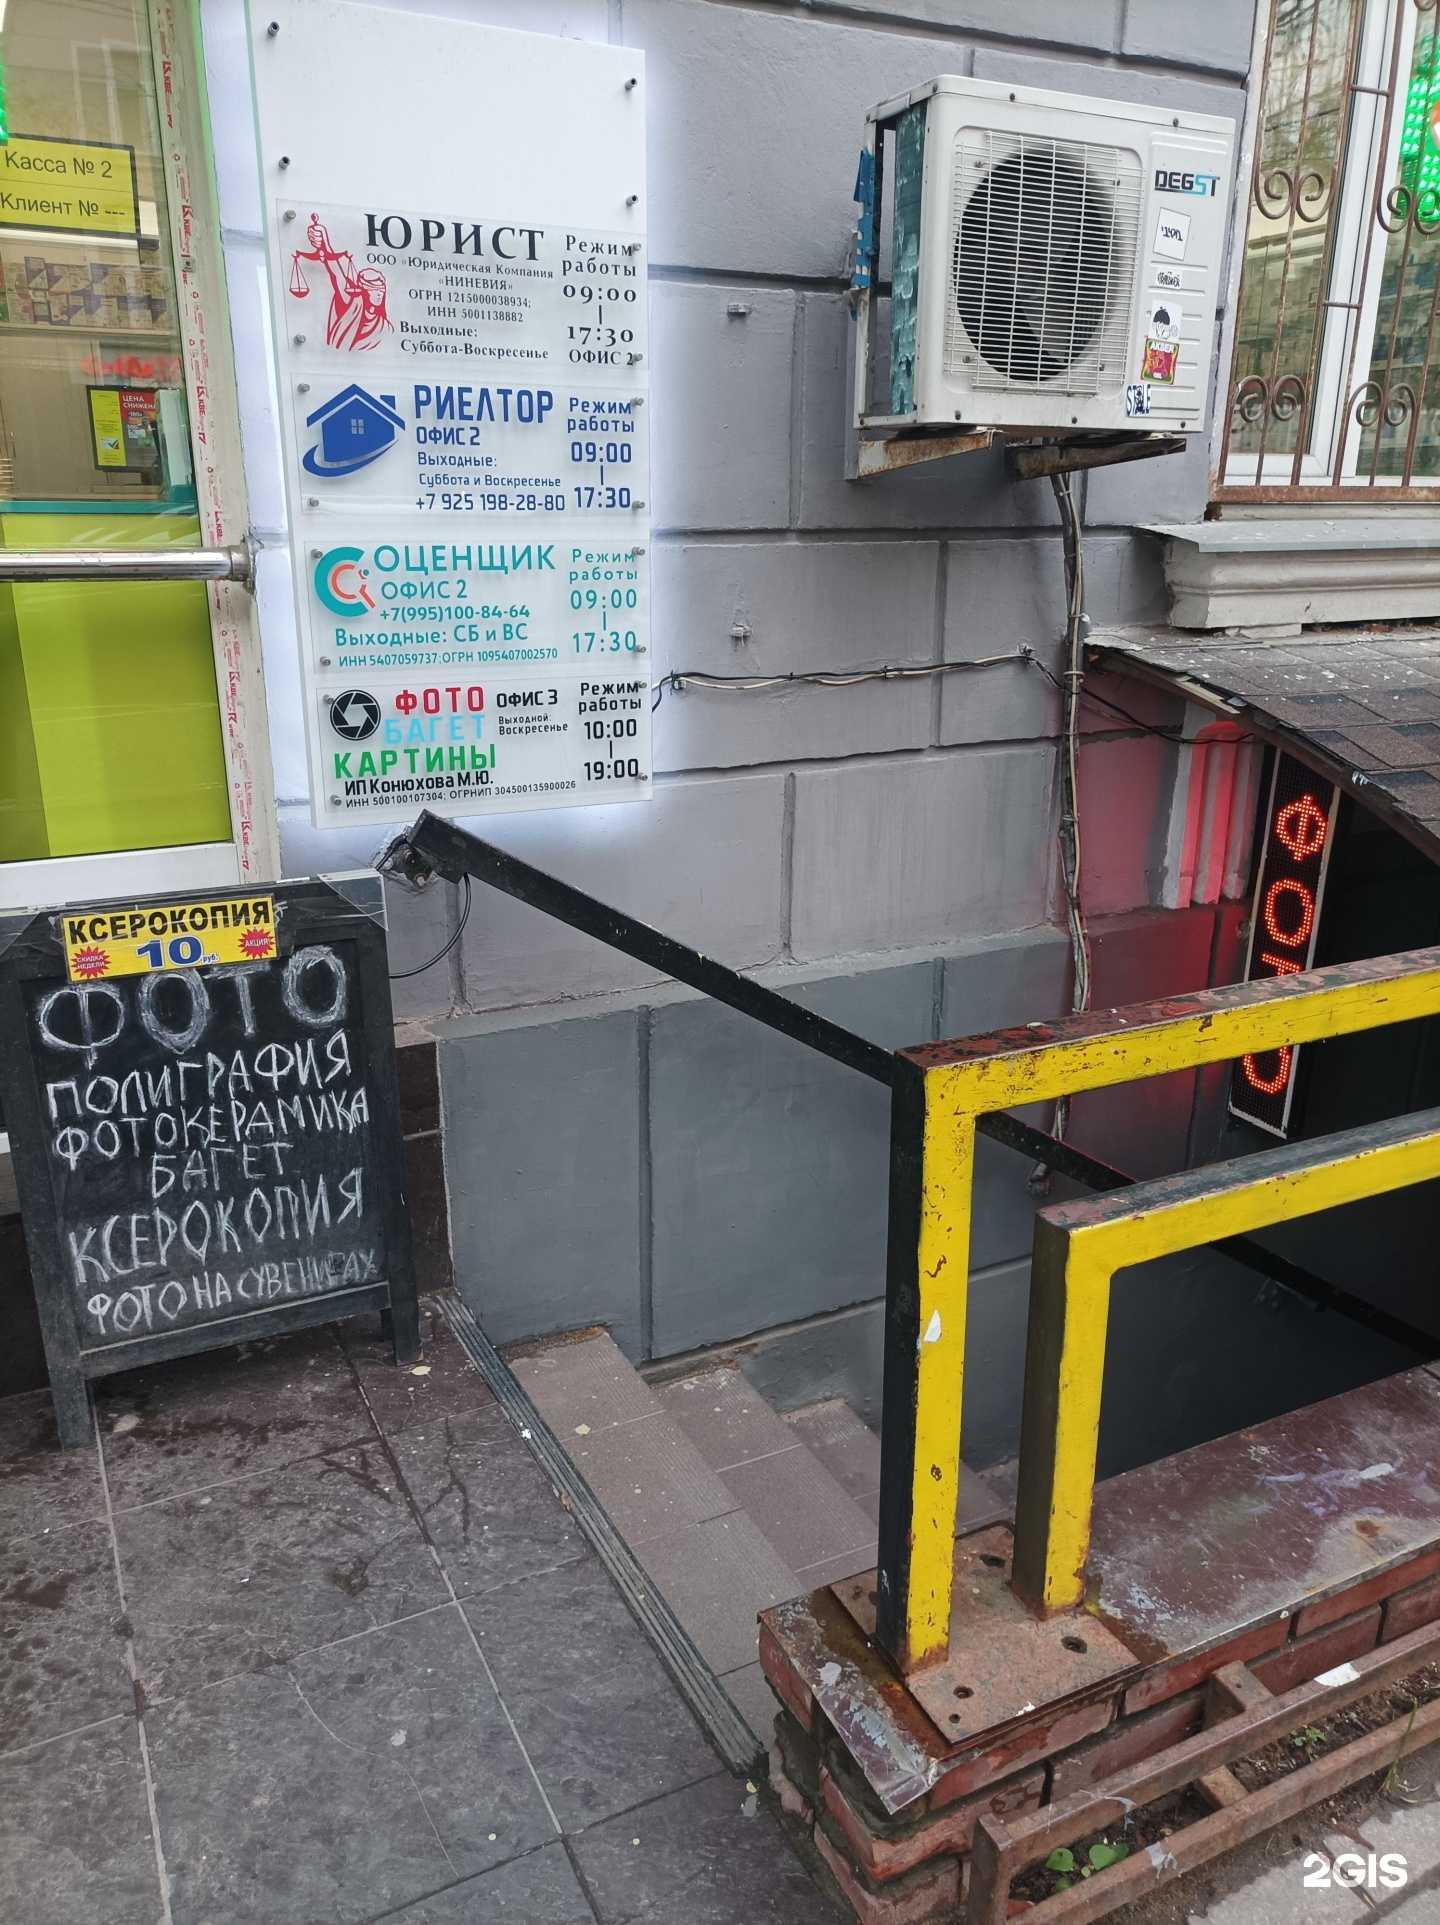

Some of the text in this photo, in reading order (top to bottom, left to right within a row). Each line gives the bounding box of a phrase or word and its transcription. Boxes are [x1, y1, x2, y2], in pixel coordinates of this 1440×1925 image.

[4, 150, 113, 179] Касса № 2
[1154, 170, 1220, 197] DEGST
[0, 191, 73, 215] Клиент
[79, 199, 99, 217] №
[364, 213, 546, 261] ЮРИСТ
[565, 234, 635, 257] Режим
[366, 252, 398, 266] ООО
[494, 265, 555, 281] Компания
[562, 256, 637, 278] работы
[438, 275, 514, 291] «НИНЕВИЯ»
[408, 288, 443, 302] ОГРН
[562, 284, 637, 305] 09:00
[427, 306, 524, 323] ИНН 5001138882
[399, 320, 479, 339] Выходные:
[567, 325, 635, 347] 17:30
[400, 338, 549, 361] Суббота-Воскресенье
[568, 348, 636, 367] ОФИС 2
[122, 394, 145, 403] ЦЕНА
[413, 384, 554, 424] РИЕЛТОР
[569, 396, 634, 415] Режим
[416, 426, 481, 446] ОФИС 2
[567, 416, 636, 434] работы
[417, 451, 498, 469] Выходные:
[571, 441, 633, 464] 09:00
[418, 472, 561, 490] Суббота и Воскресенье
[416, 493, 566, 513] +7 925 198-28-80
[573, 486, 632, 510] 17:30
[374, 544, 556, 576] ОЦЕНЩИК
[572, 548, 636, 565] Режим
[569, 567, 638, 585] работы
[381, 579, 468, 601] ОФИС 2
[570, 588, 638, 610] 09:00
[379, 604, 530, 624] +7(995)100-84-64
[335, 622, 529, 648] Выходные: СБ и ВС
[572, 631, 638, 653] 17:30
[338, 655, 367, 667] ИНН
[477, 647, 559, 662] 1095407002570
[496, 688, 559, 708] ОФИС 3
[580, 681, 640, 697] Режим
[395, 685, 486, 716] ФОТО
[578, 698, 642, 715] работы
[383, 714, 487, 745] БАГЕТ
[498, 712, 552, 725] Выходной:
[499, 722, 569, 736] Воскресенье
[584, 718, 638, 740] 10:00
[334, 743, 496, 779] КАРТИНЫ
[583, 758, 640, 782] 19:00
[344, 769, 494, 797] ИП Конюхова М.Ю.
[346, 797, 370, 809] ИНН
[449, 787, 492, 801] ОГРНИП
[494, 780, 577, 797] 304500135900026
[68, 900, 271, 945] КСЕРОКОПИЯ
[136, 936, 219, 970] 10 руб.
[36, 944, 348, 1070] ФОТО
[46, 1028, 352, 1120] ПОЛИГРАФИЯ
[56, 1087, 370, 1171] ФОТОКЕРАМИКА
[150, 1141, 294, 1199] БАГЕТ
[69, 1166, 364, 1286] КСЕРОКОПИЯ
[87, 1281, 188, 1335] ФОТО
[192, 1271, 233, 1310] НА
